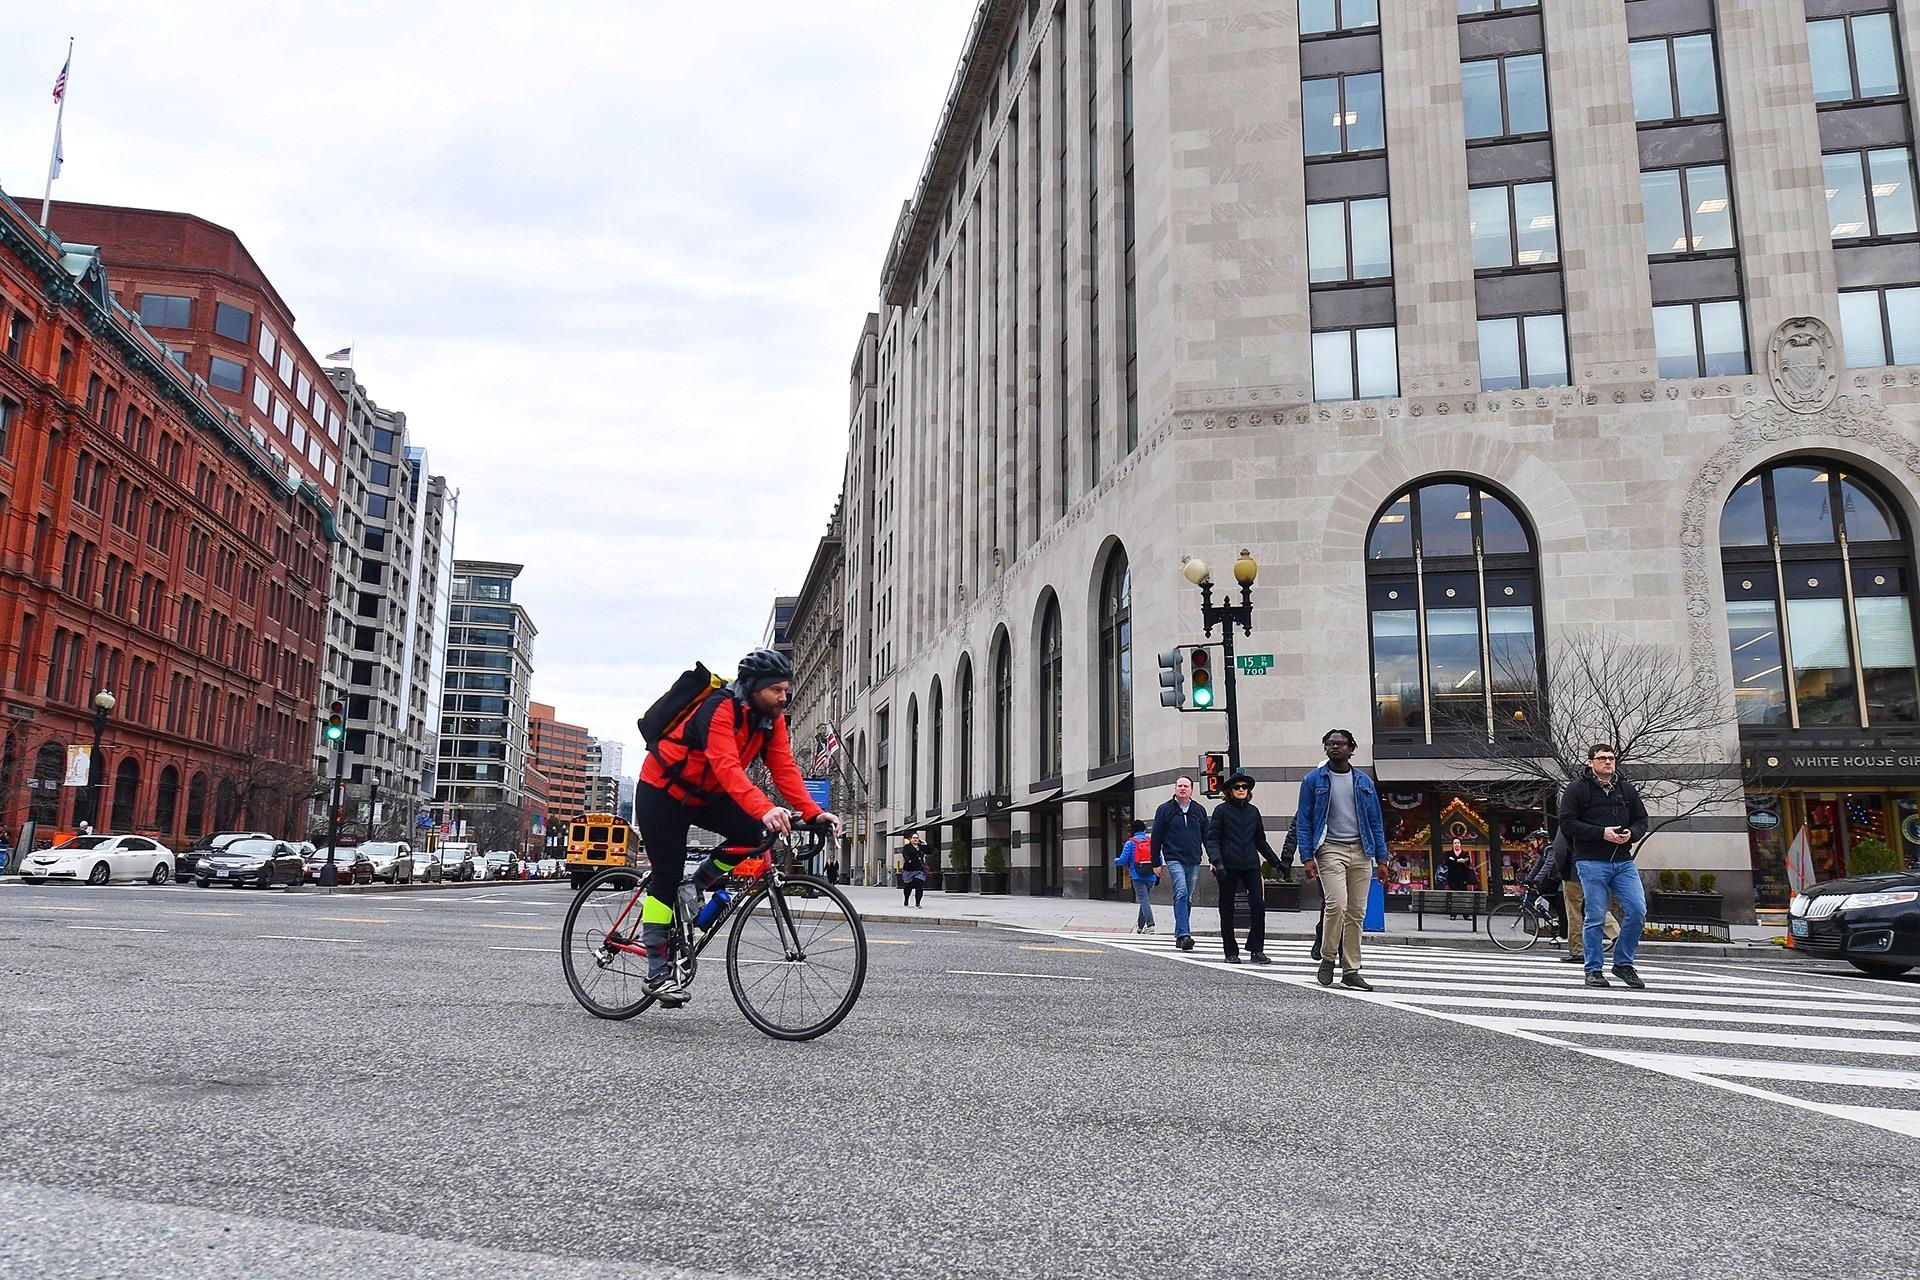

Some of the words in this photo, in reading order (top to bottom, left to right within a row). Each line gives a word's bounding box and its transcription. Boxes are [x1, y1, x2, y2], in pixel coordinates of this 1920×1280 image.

[1243, 657, 1254, 667] 15
[1791, 757, 1840, 767] WHITE
[1843, 756, 1894, 766] HOUSE
[1209, 776, 1218, 792] 12
